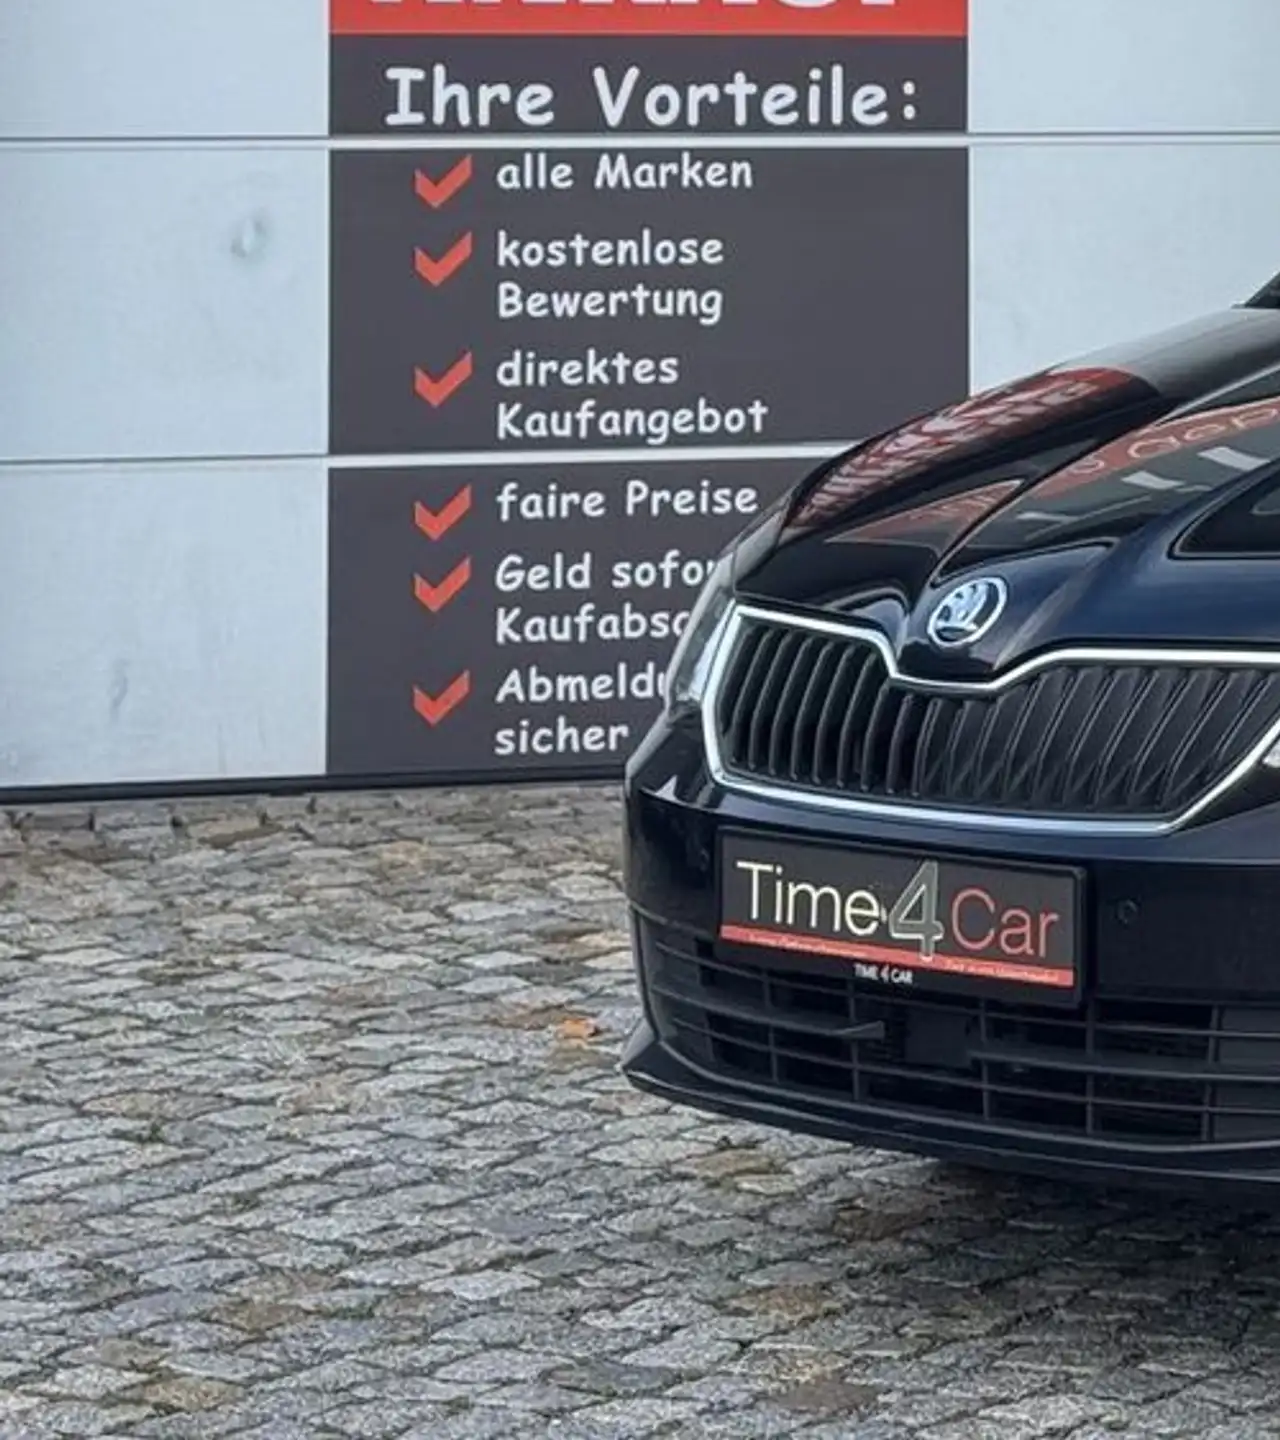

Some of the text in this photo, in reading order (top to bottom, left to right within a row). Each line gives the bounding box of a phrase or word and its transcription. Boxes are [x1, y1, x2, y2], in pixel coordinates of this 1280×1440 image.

[385, 62, 917, 128] Ihre Vorteile:
[495, 150, 754, 191] alle Marken
[497, 227, 724, 268] kostenlose
[497, 280, 724, 327] Bewertung
[495, 347, 679, 388] direktes
[496, 396, 770, 445] Kaufangebot
[495, 478, 758, 523] faire Preise
[494, 550, 592, 592] Geld
[493, 714, 630, 755] sicher
